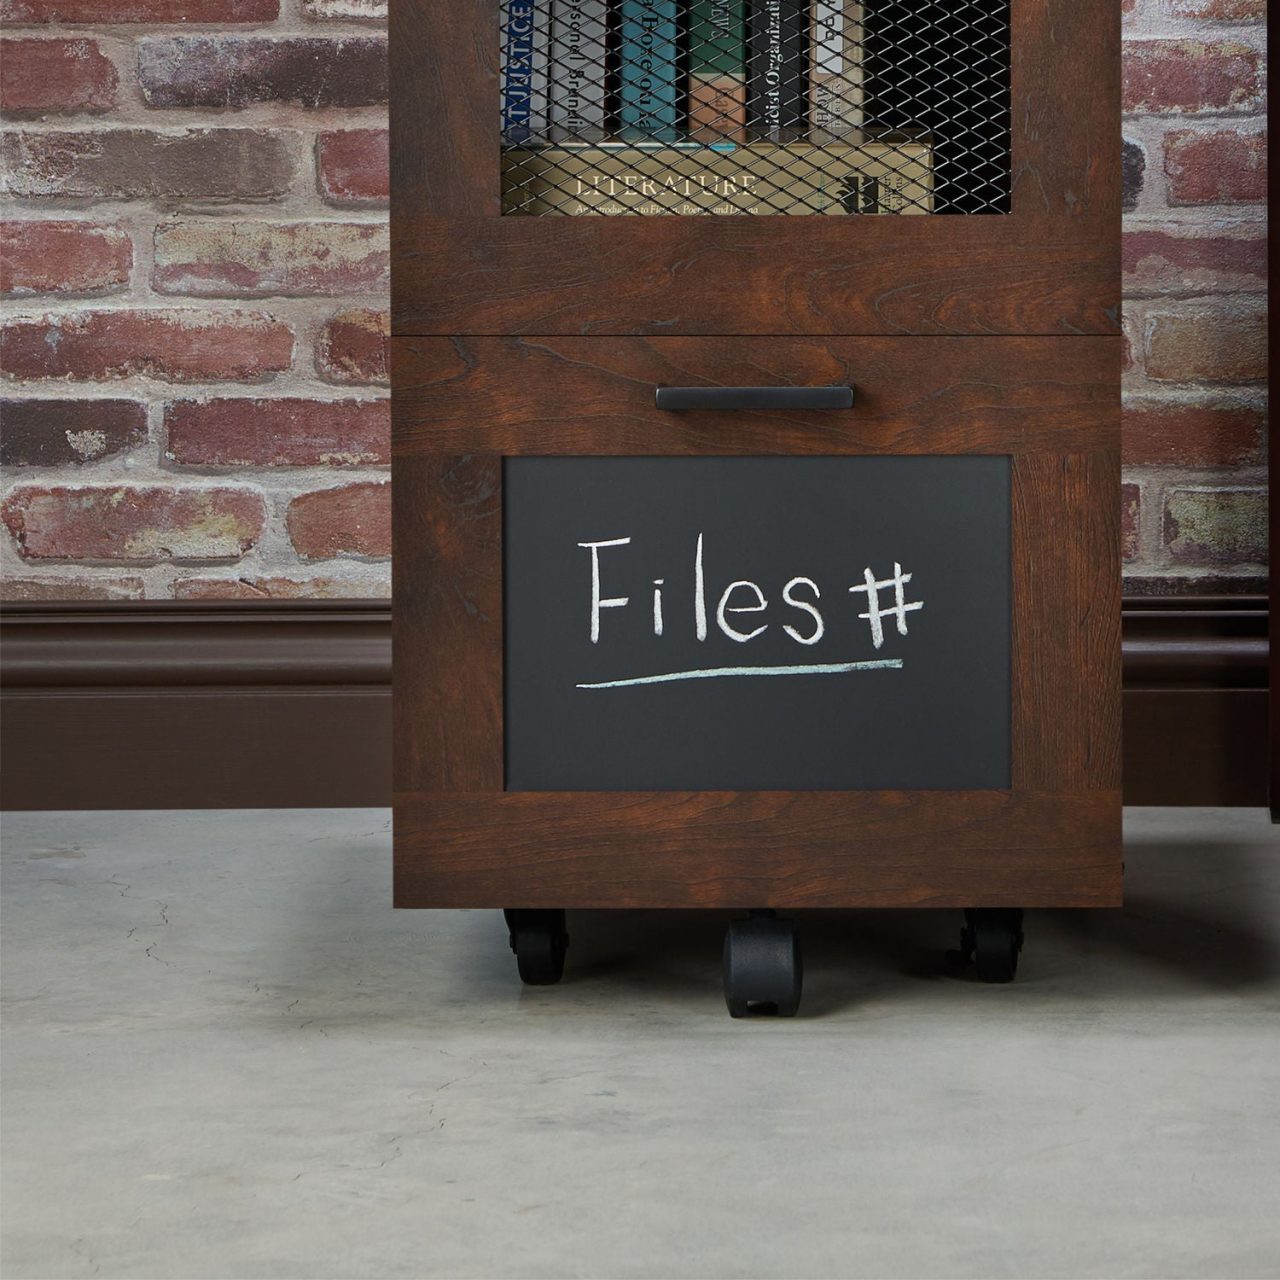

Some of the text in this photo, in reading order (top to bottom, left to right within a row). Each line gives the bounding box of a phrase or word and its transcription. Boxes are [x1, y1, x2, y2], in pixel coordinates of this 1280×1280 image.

[509, 6, 531, 98] JUSTICE
[576, 175, 757, 196] LITERATURE
[577, 532, 825, 645] Files
